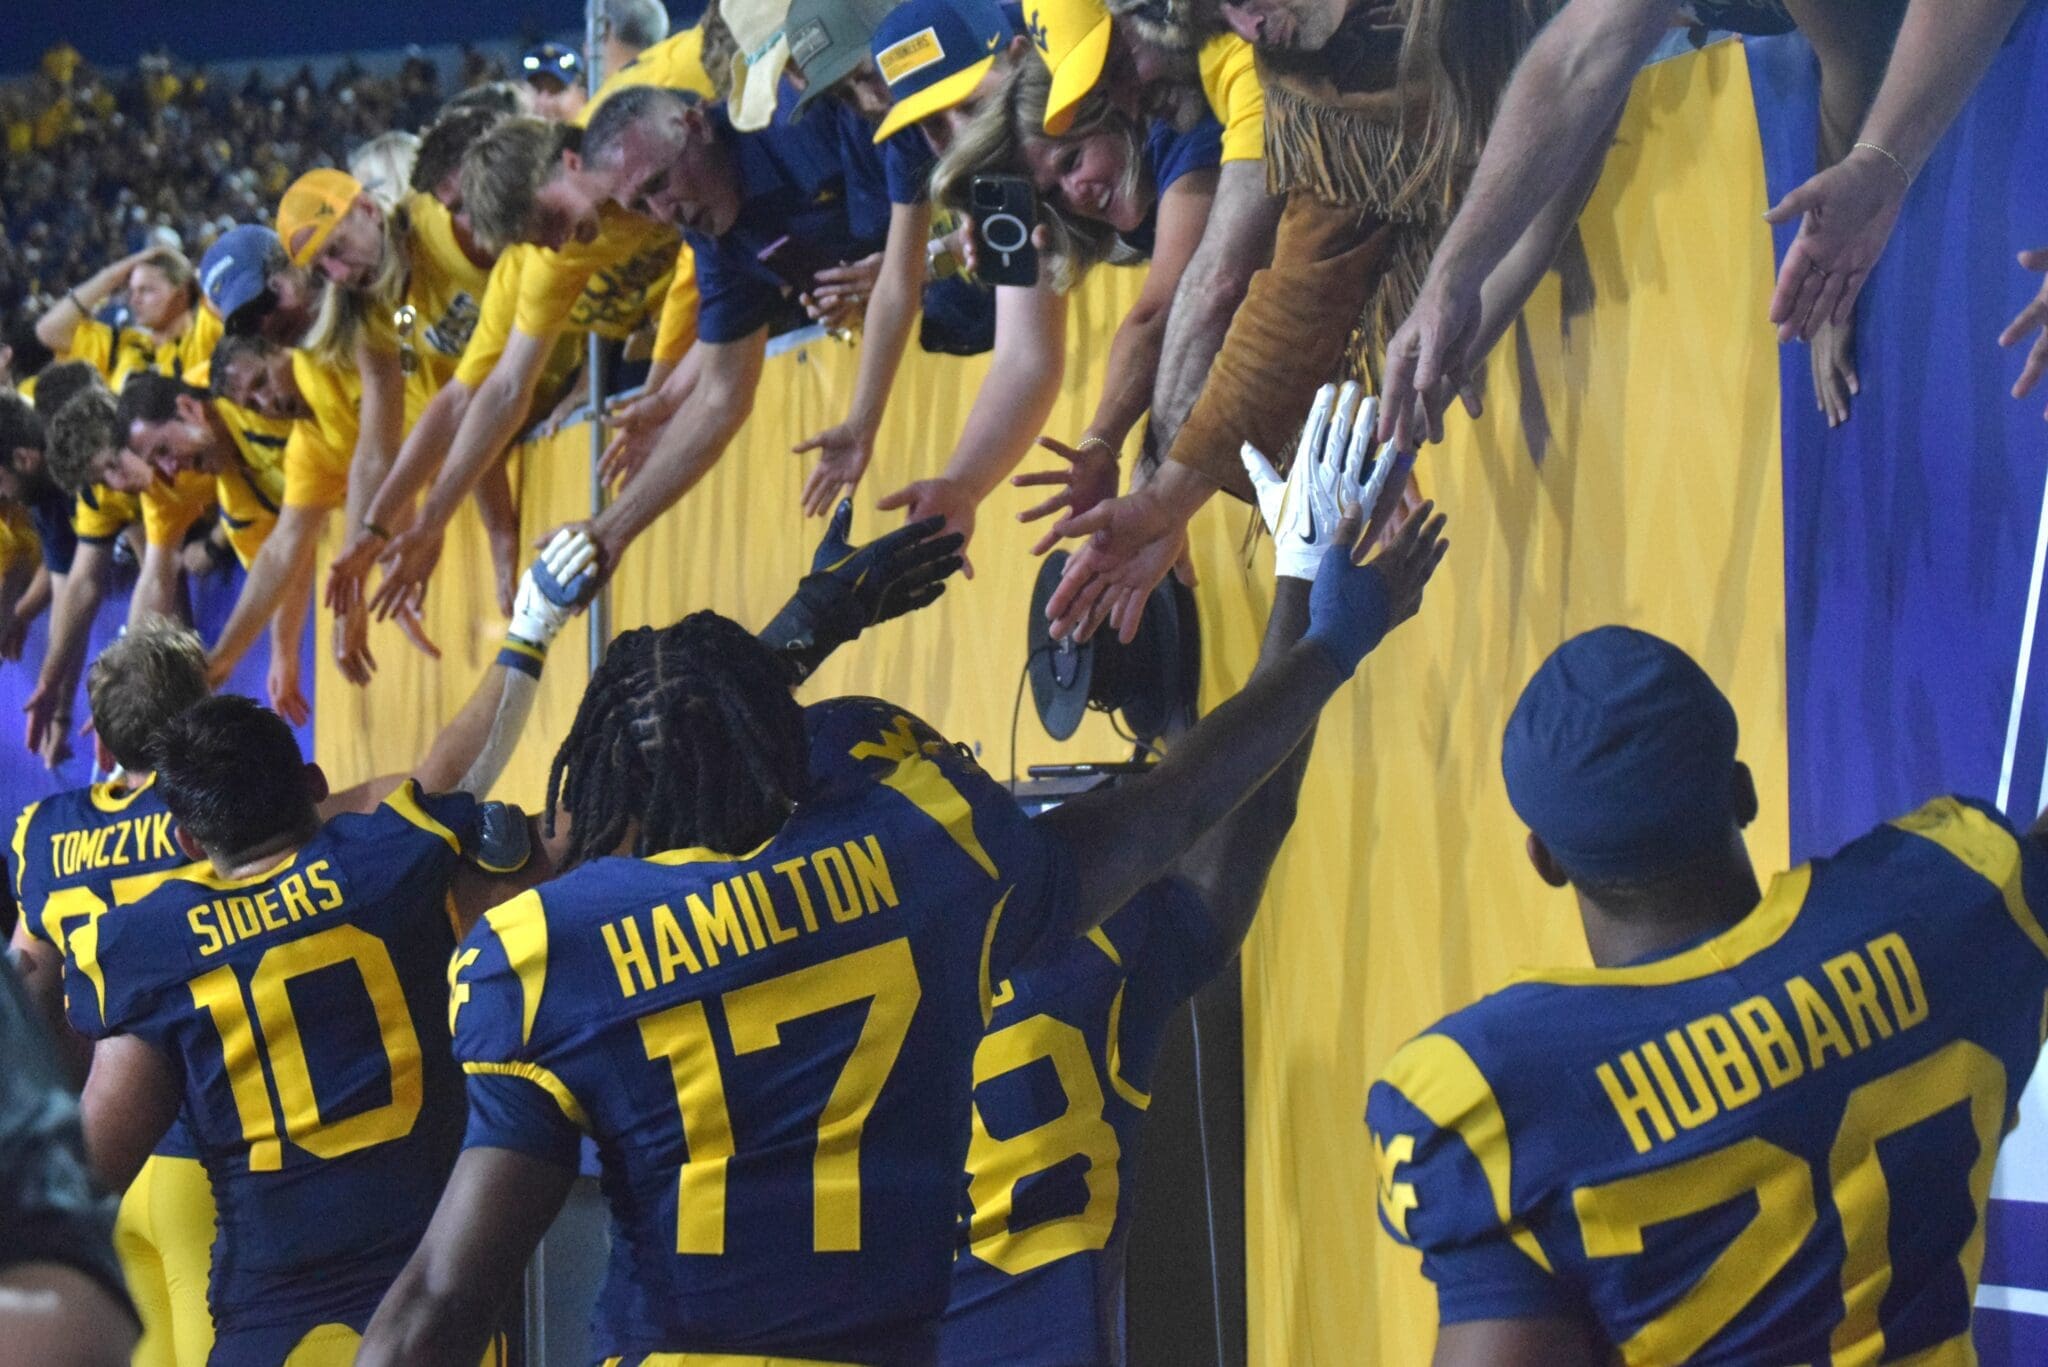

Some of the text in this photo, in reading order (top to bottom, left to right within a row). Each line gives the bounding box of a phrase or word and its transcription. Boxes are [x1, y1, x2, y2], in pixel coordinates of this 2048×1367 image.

[51, 811, 176, 878] TOMCZYK
[187, 859, 344, 957] SIDERS
[601, 834, 899, 998] HAMILTON
[188, 923, 424, 1172] 10
[637, 936, 922, 1255] 17
[954, 1013, 1121, 1276] 8
[1595, 931, 1929, 1154] HUBBARD
[1572, 1038, 2007, 1367] 20
